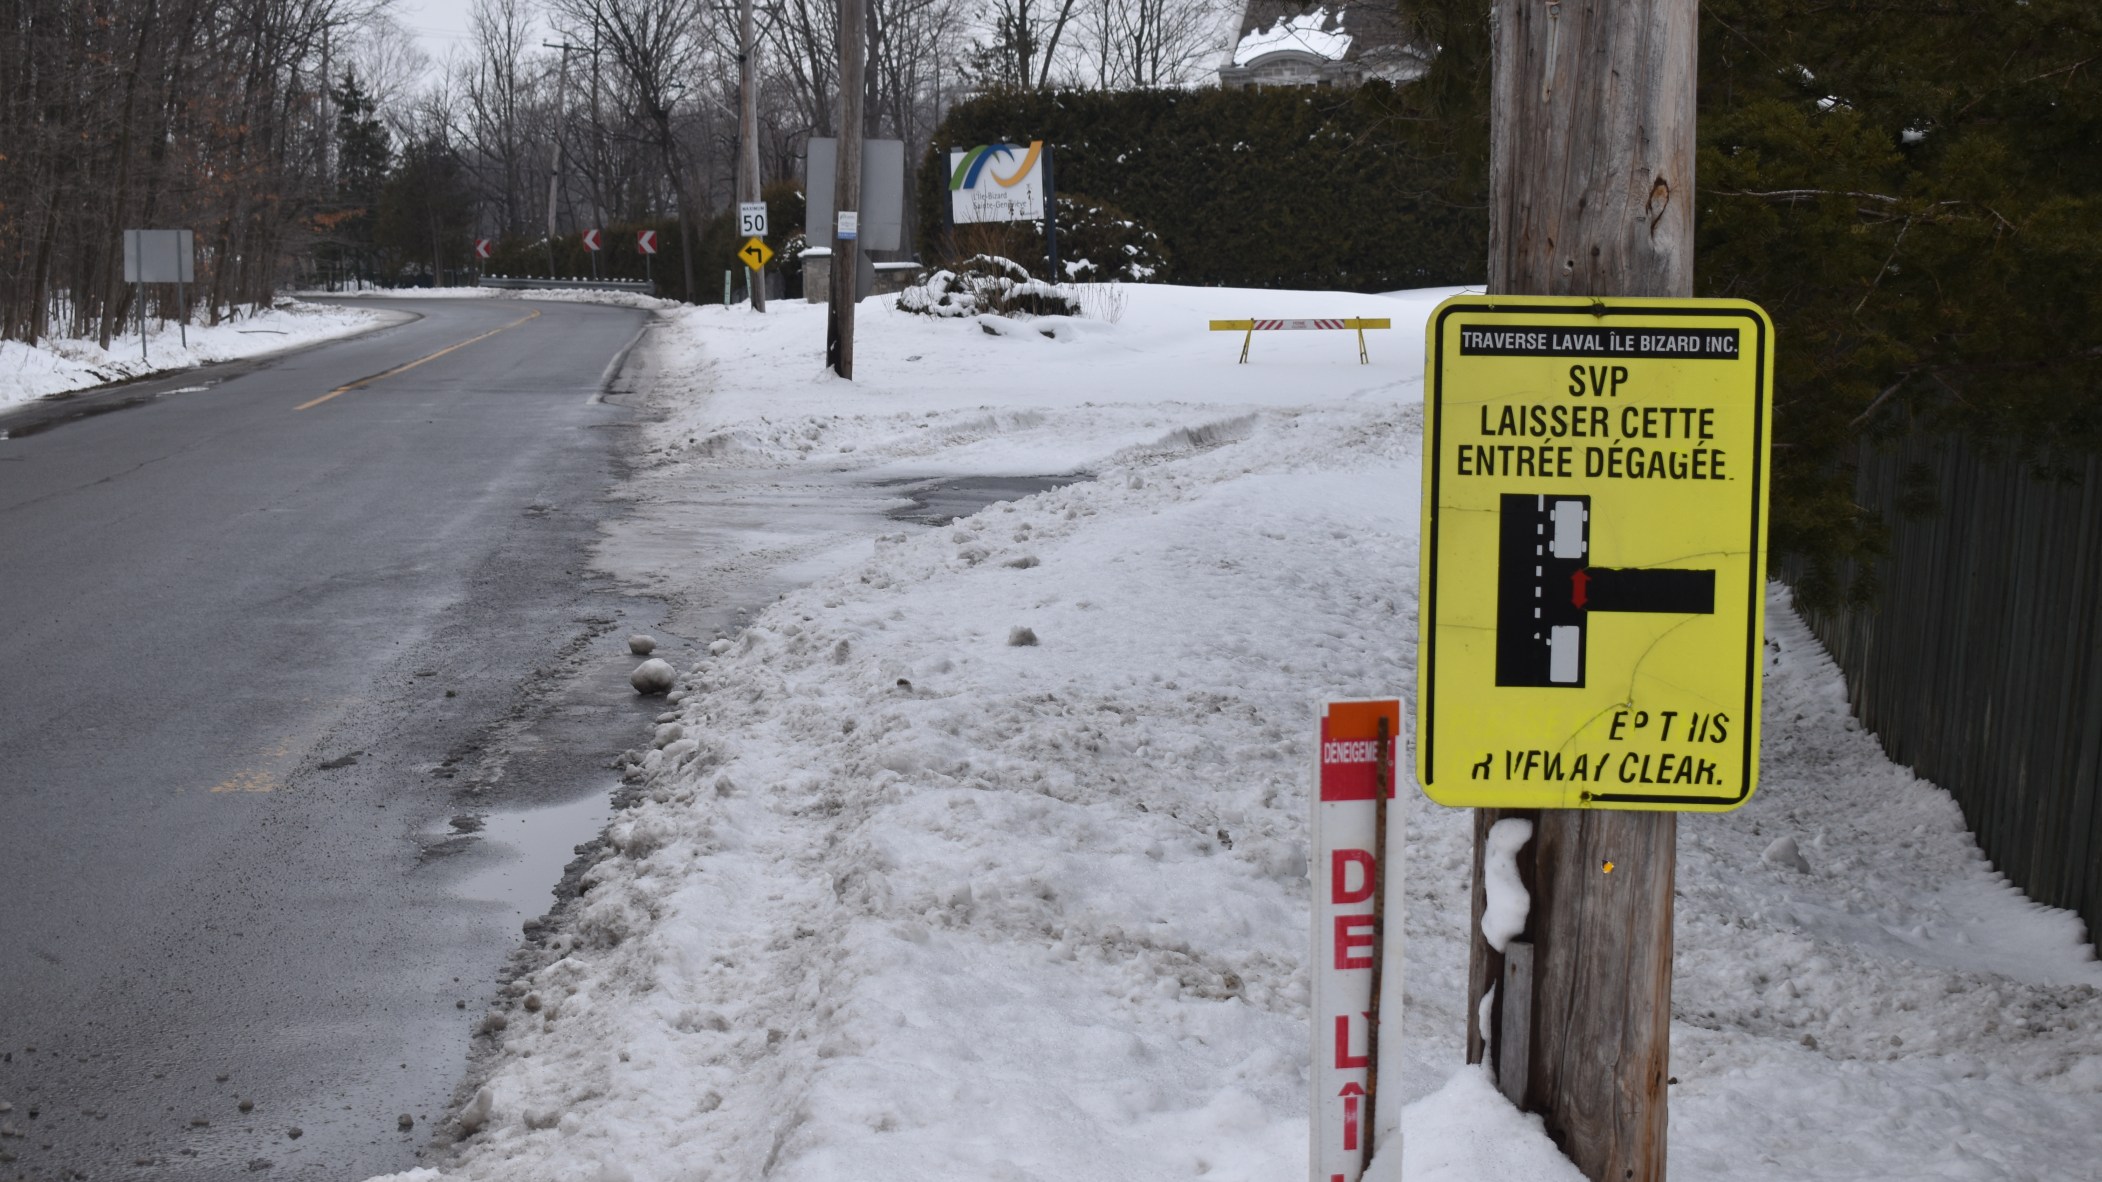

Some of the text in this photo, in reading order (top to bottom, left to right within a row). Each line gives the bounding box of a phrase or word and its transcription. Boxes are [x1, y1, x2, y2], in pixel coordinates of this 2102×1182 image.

[743, 214, 764, 232] 50
[1462, 331, 1738, 353] TRAVERSE LAVAL ÎLE BIZARD INC.
[1568, 364, 1628, 397] SVP
[1481, 404, 1714, 439] LAISSER CETTE
[1457, 438, 1572, 477] ENTRÉE
[1324, 738, 1391, 764] DÉNEIGEME
[1618, 752, 1722, 785] CLEAR.
